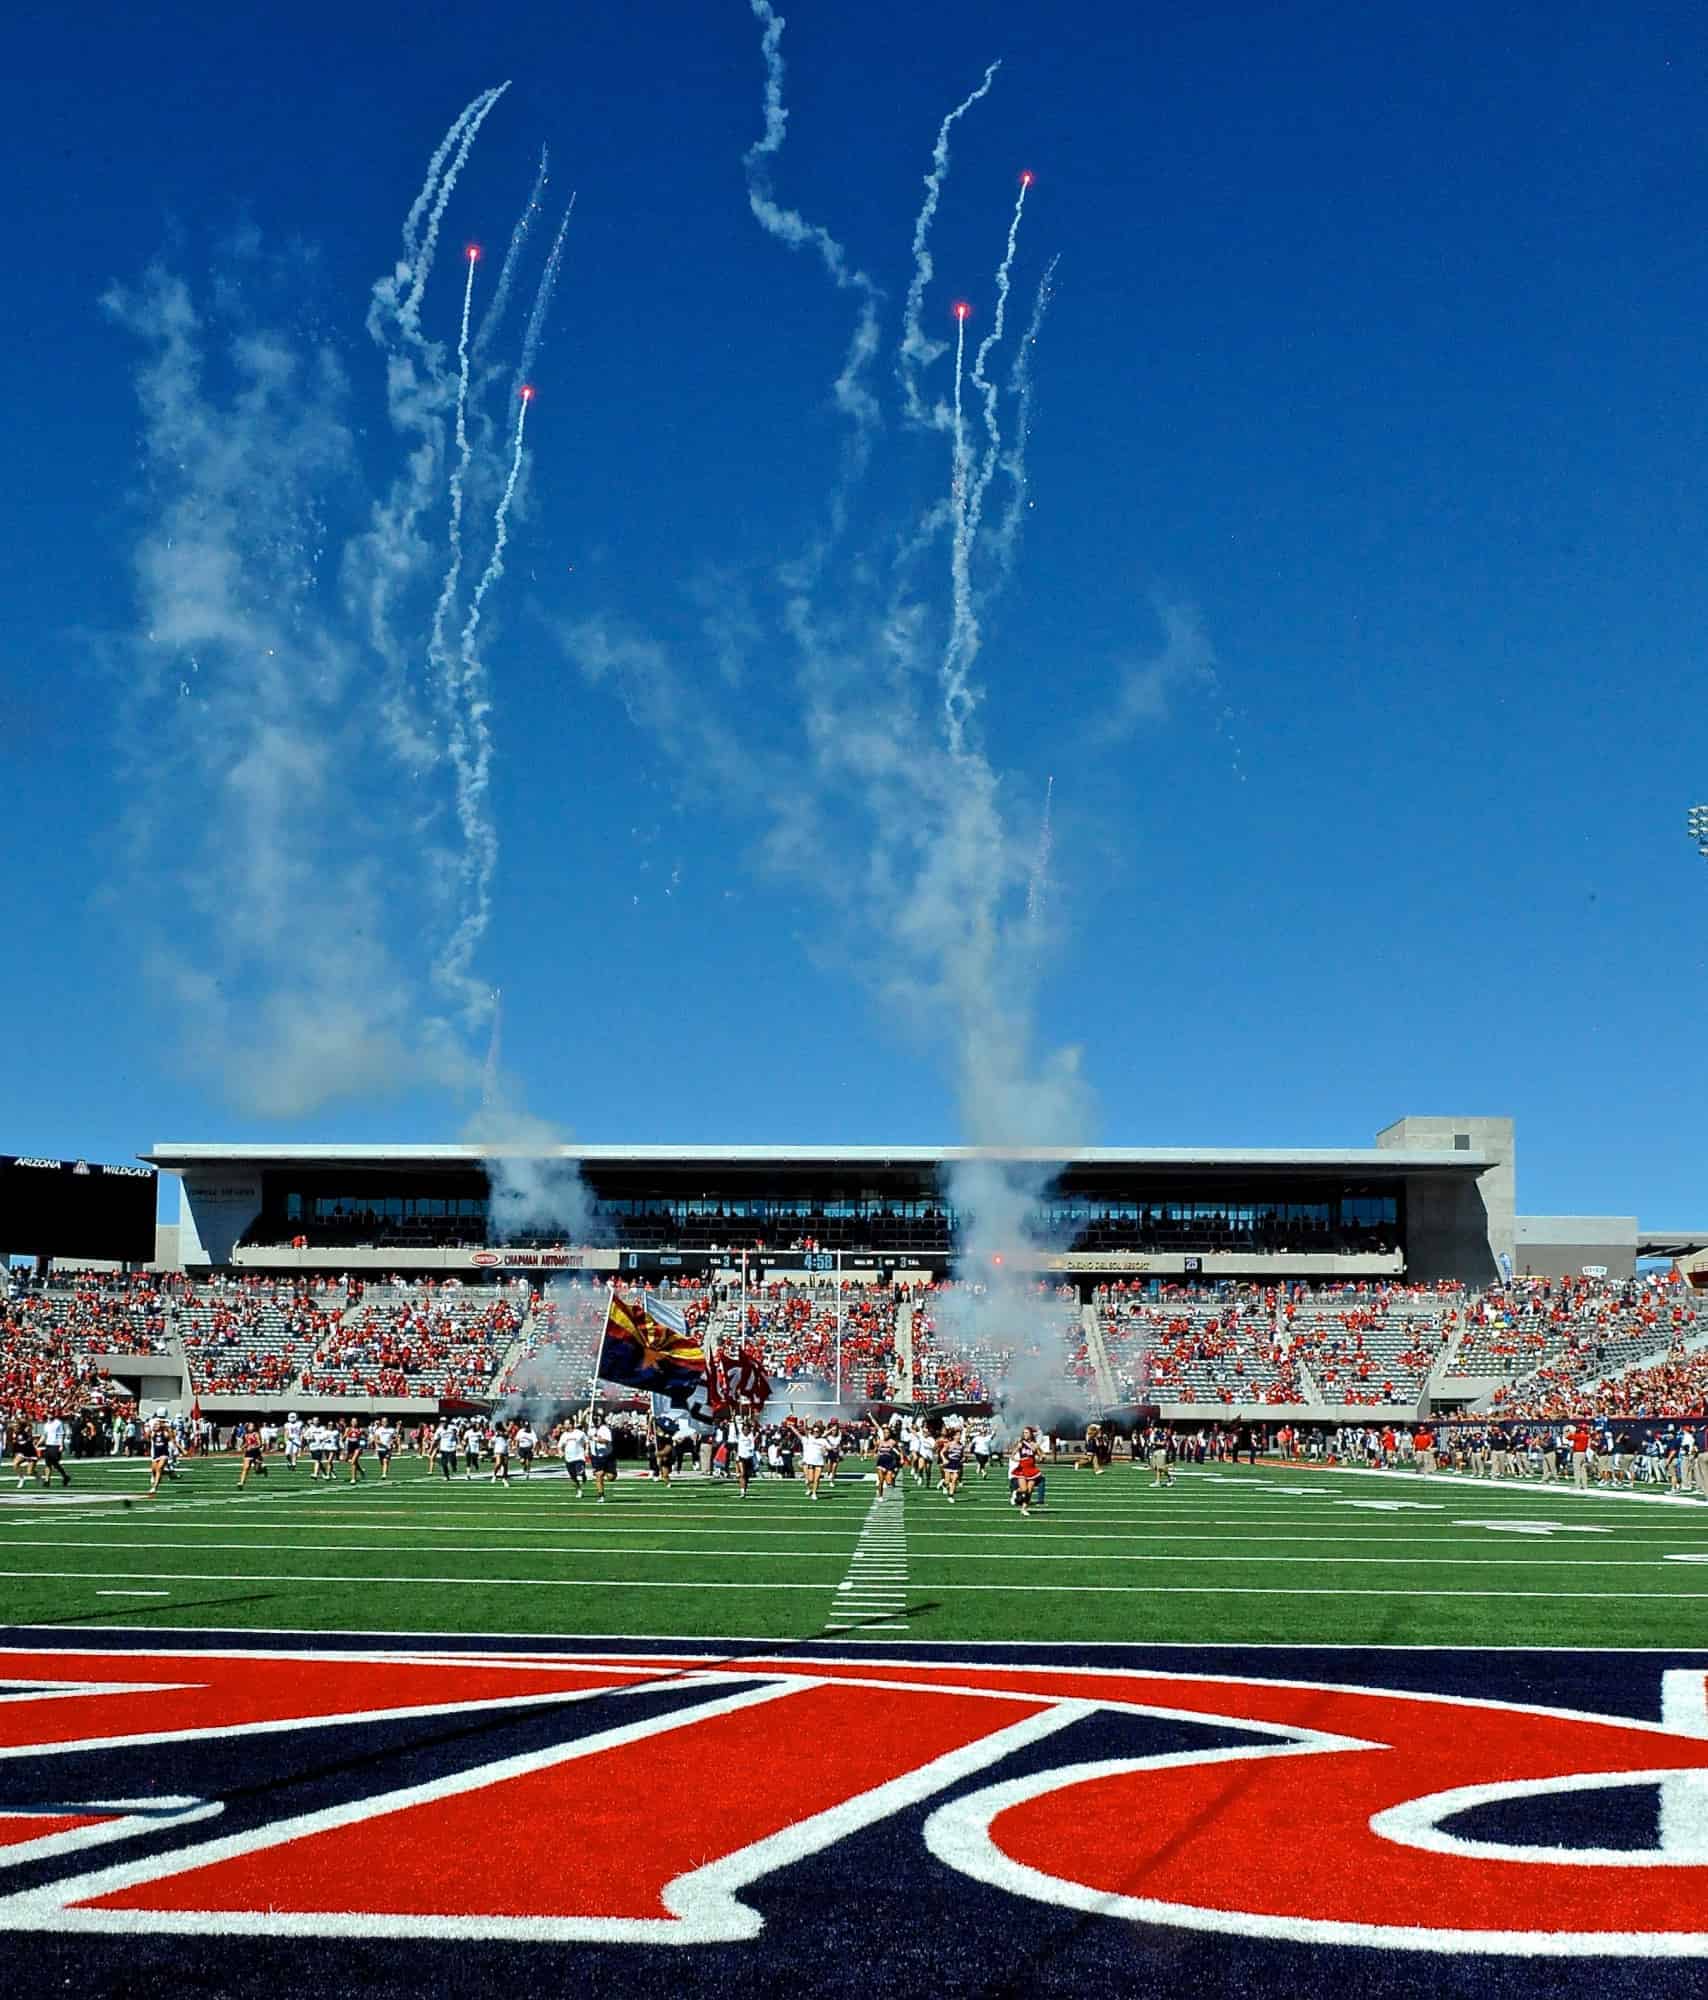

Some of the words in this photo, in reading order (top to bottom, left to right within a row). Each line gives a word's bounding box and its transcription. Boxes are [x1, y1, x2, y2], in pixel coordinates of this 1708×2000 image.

[14, 1157, 61, 1169] ARIZONA
[103, 1165, 152, 1177] WILDCATS
[504, 1255, 538, 1265] CHAPMAN
[804, 1255, 833, 1269] 4:58
